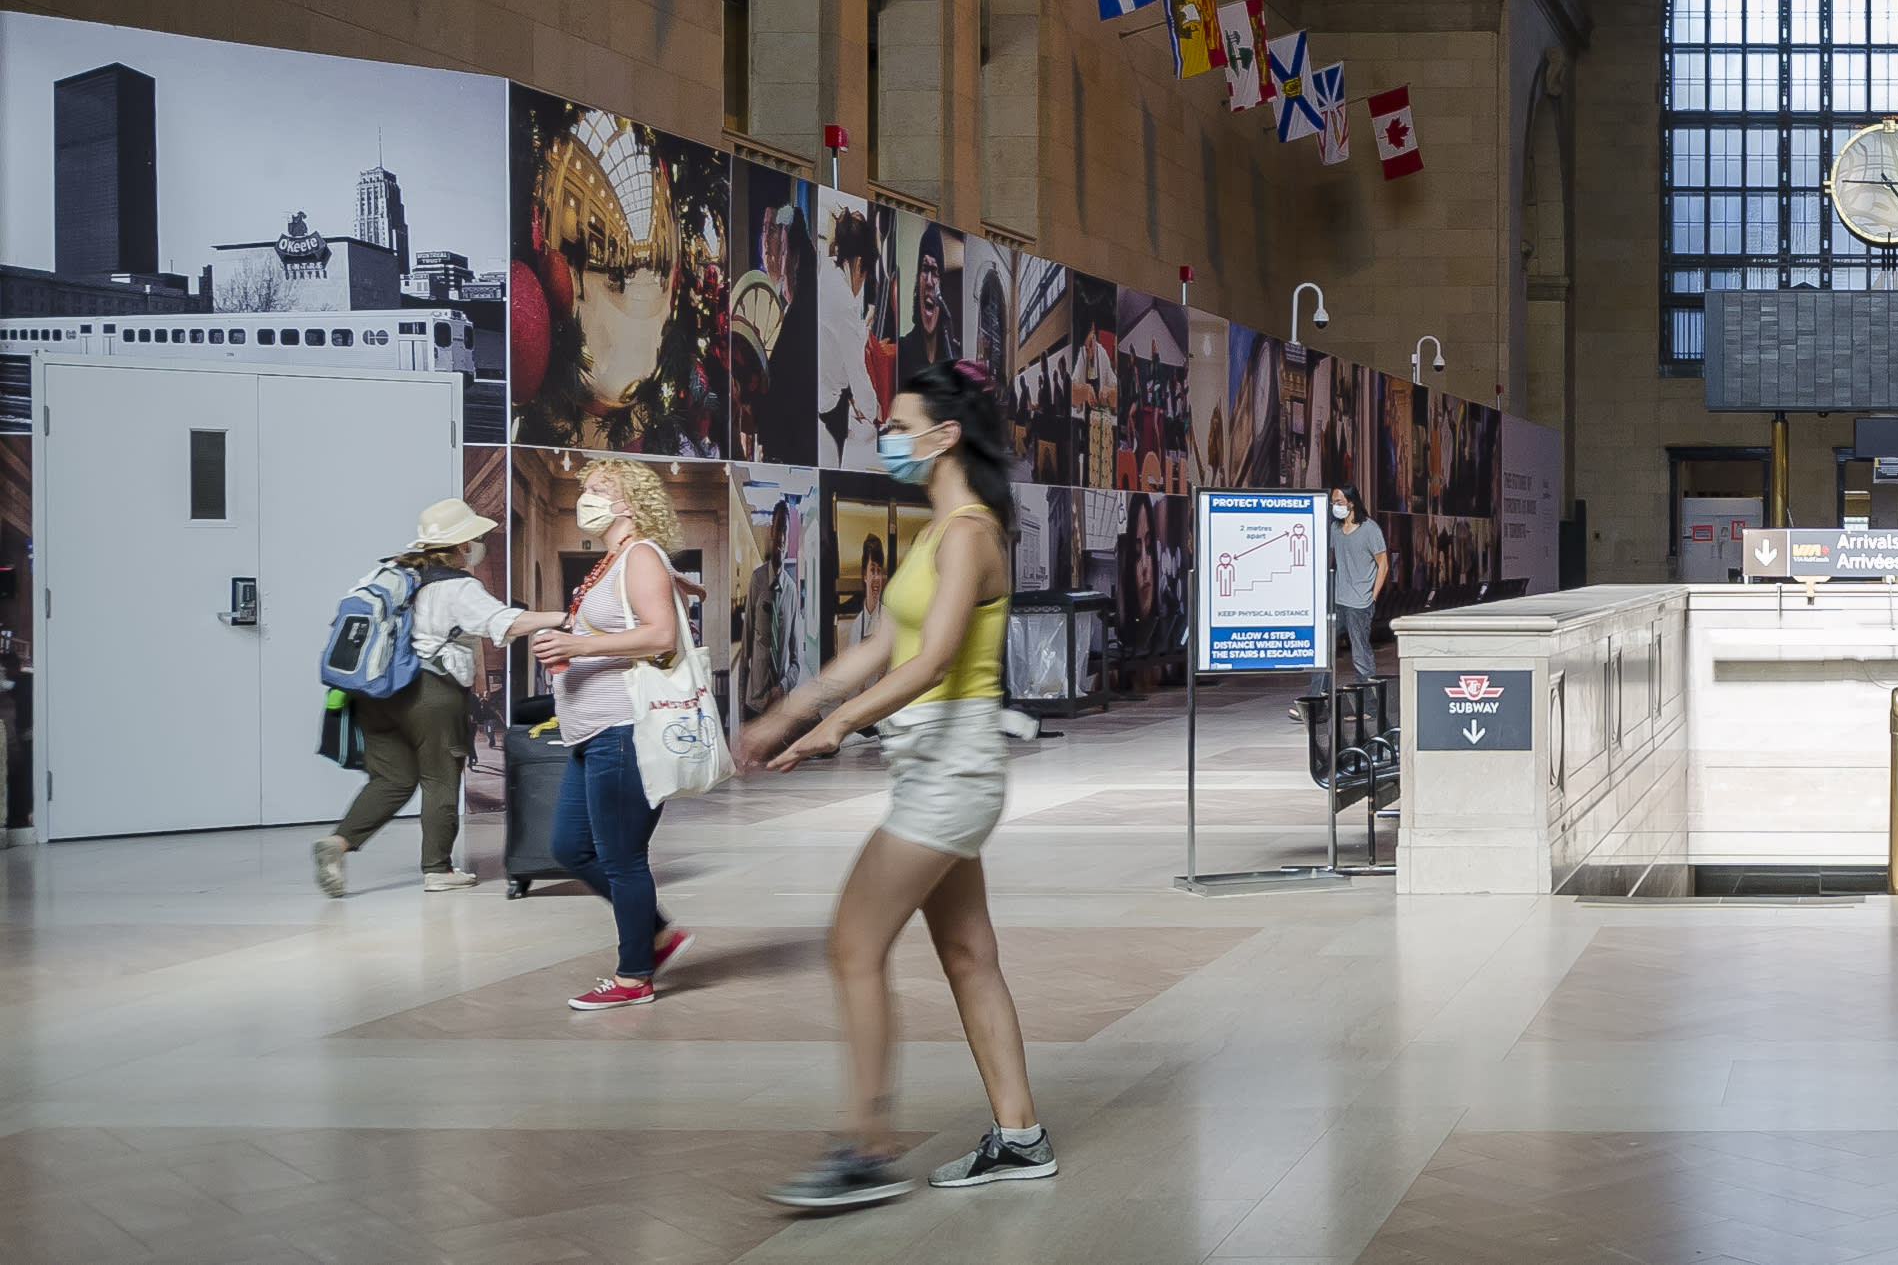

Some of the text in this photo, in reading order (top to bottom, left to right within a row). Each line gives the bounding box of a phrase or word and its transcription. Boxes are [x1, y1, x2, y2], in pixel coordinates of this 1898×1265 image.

[1213, 499, 1310, 508] PROTECT YOURSELF
[1231, 631, 1296, 640] ALLOW 4 STEPS
[1214, 640, 1310, 649] DISTANCE WHEN USING
[1212, 649, 1314, 659] THE STAIRS & ESCALATOR
[1448, 702, 1499, 714] SUBWAY
